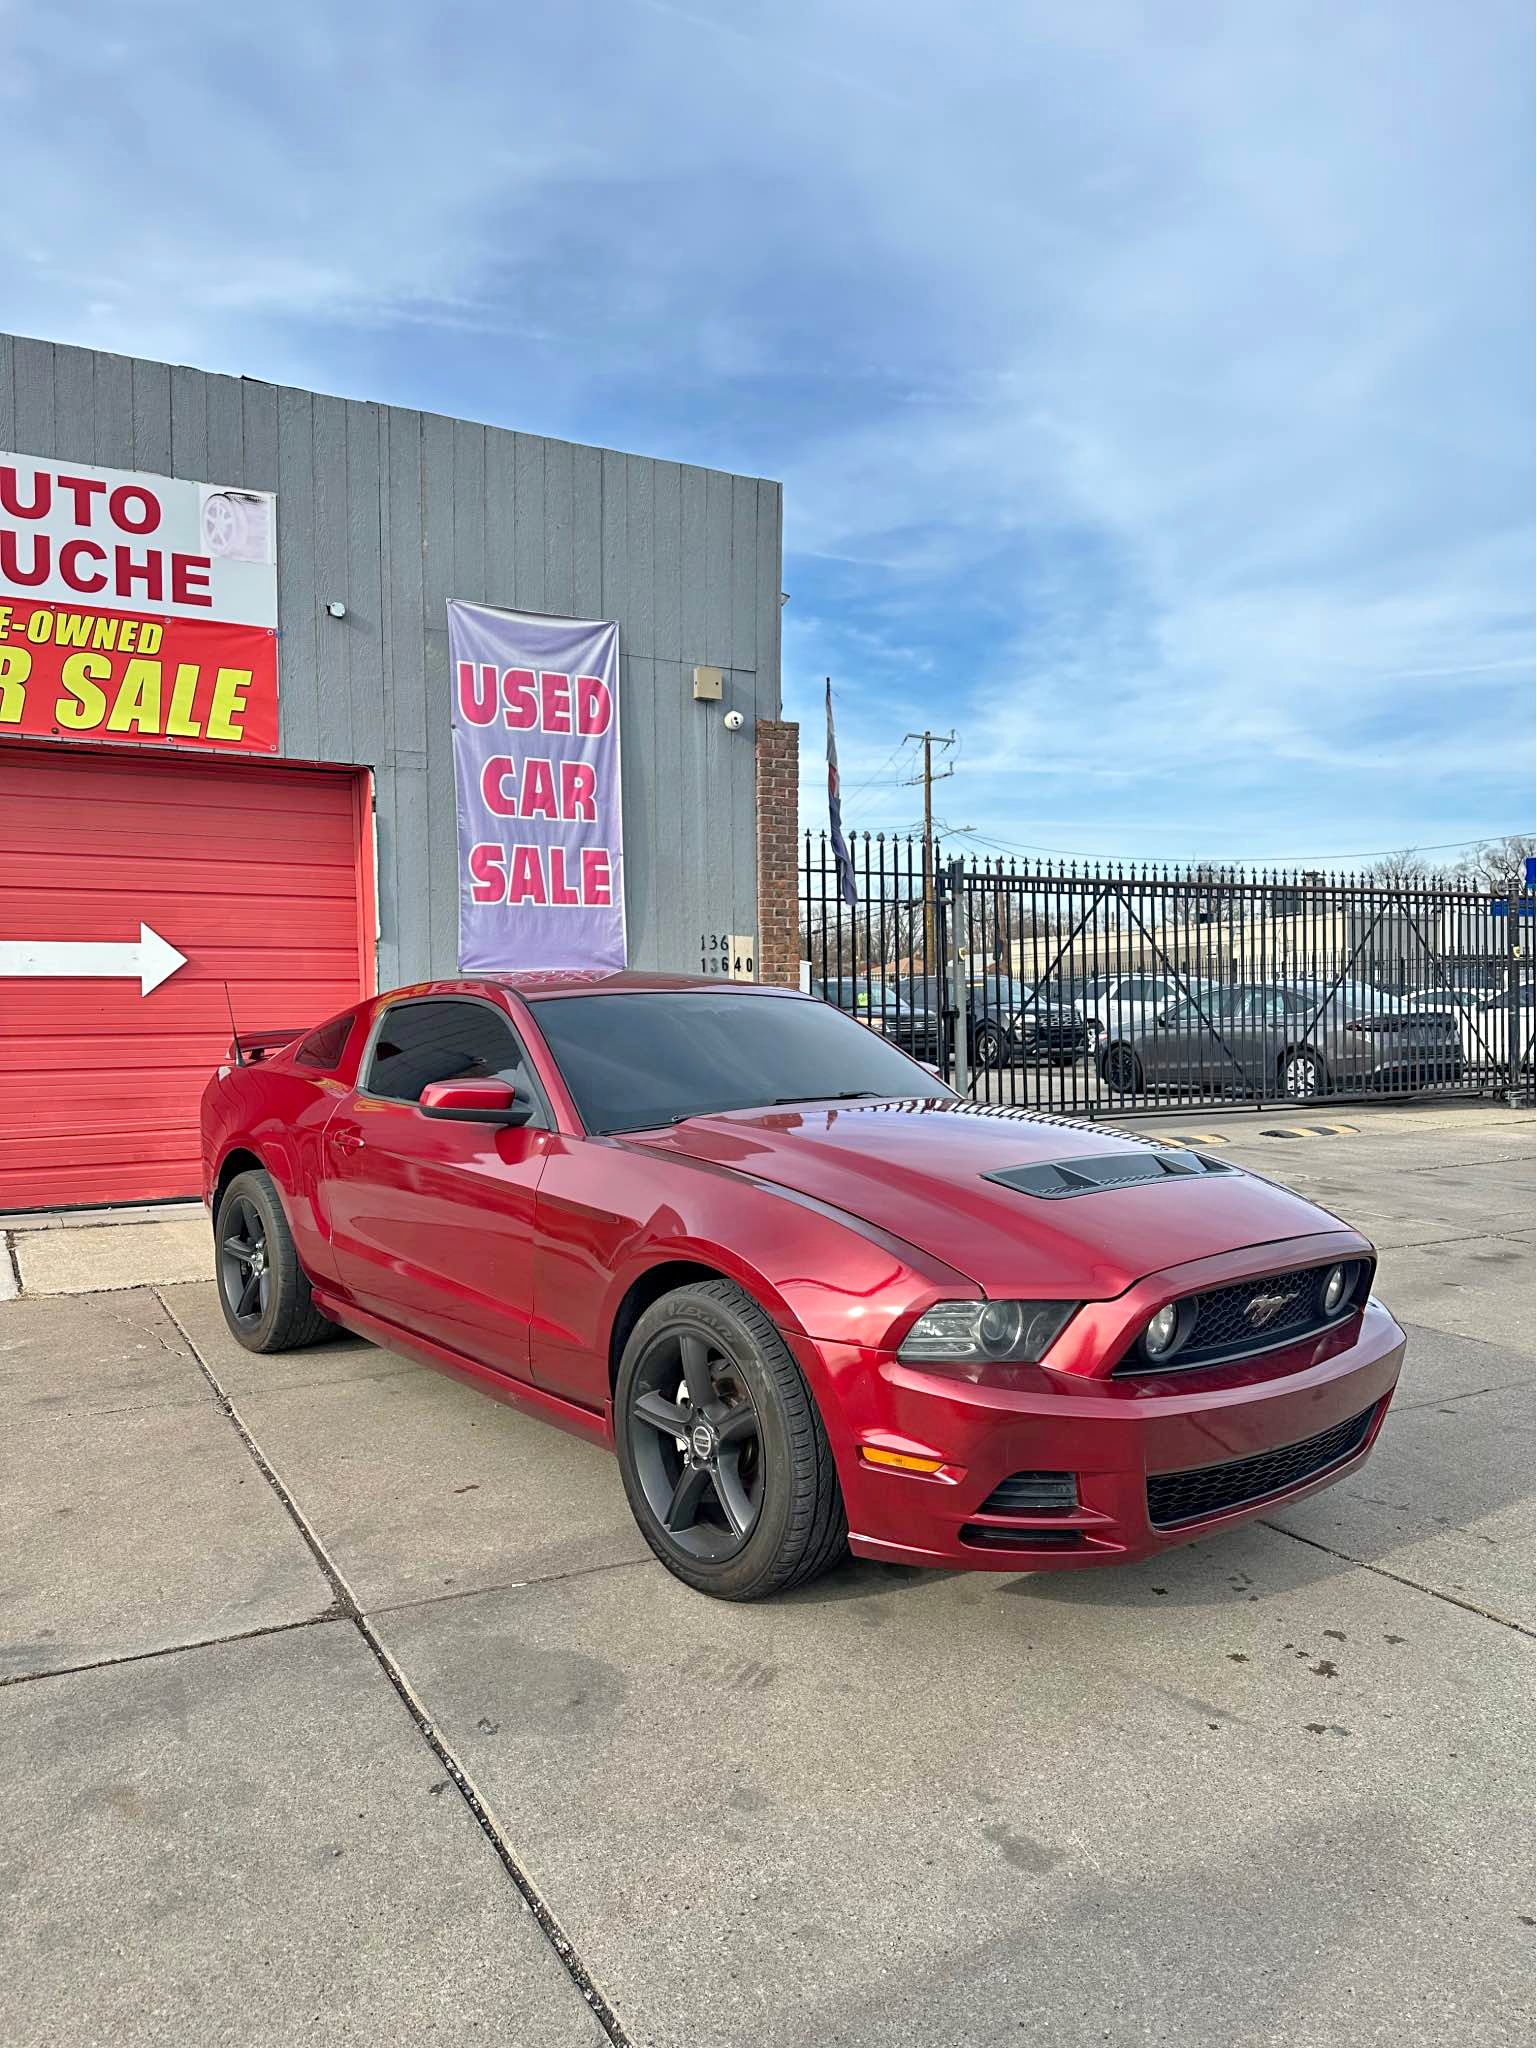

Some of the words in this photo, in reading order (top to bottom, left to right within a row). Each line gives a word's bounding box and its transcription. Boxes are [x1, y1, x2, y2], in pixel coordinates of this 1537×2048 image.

[54, 651, 253, 741] SALE
[457, 661, 612, 737] USED
[480, 755, 597, 823] CAR
[468, 842, 613, 908] SALE
[701, 934, 729, 951] 136
